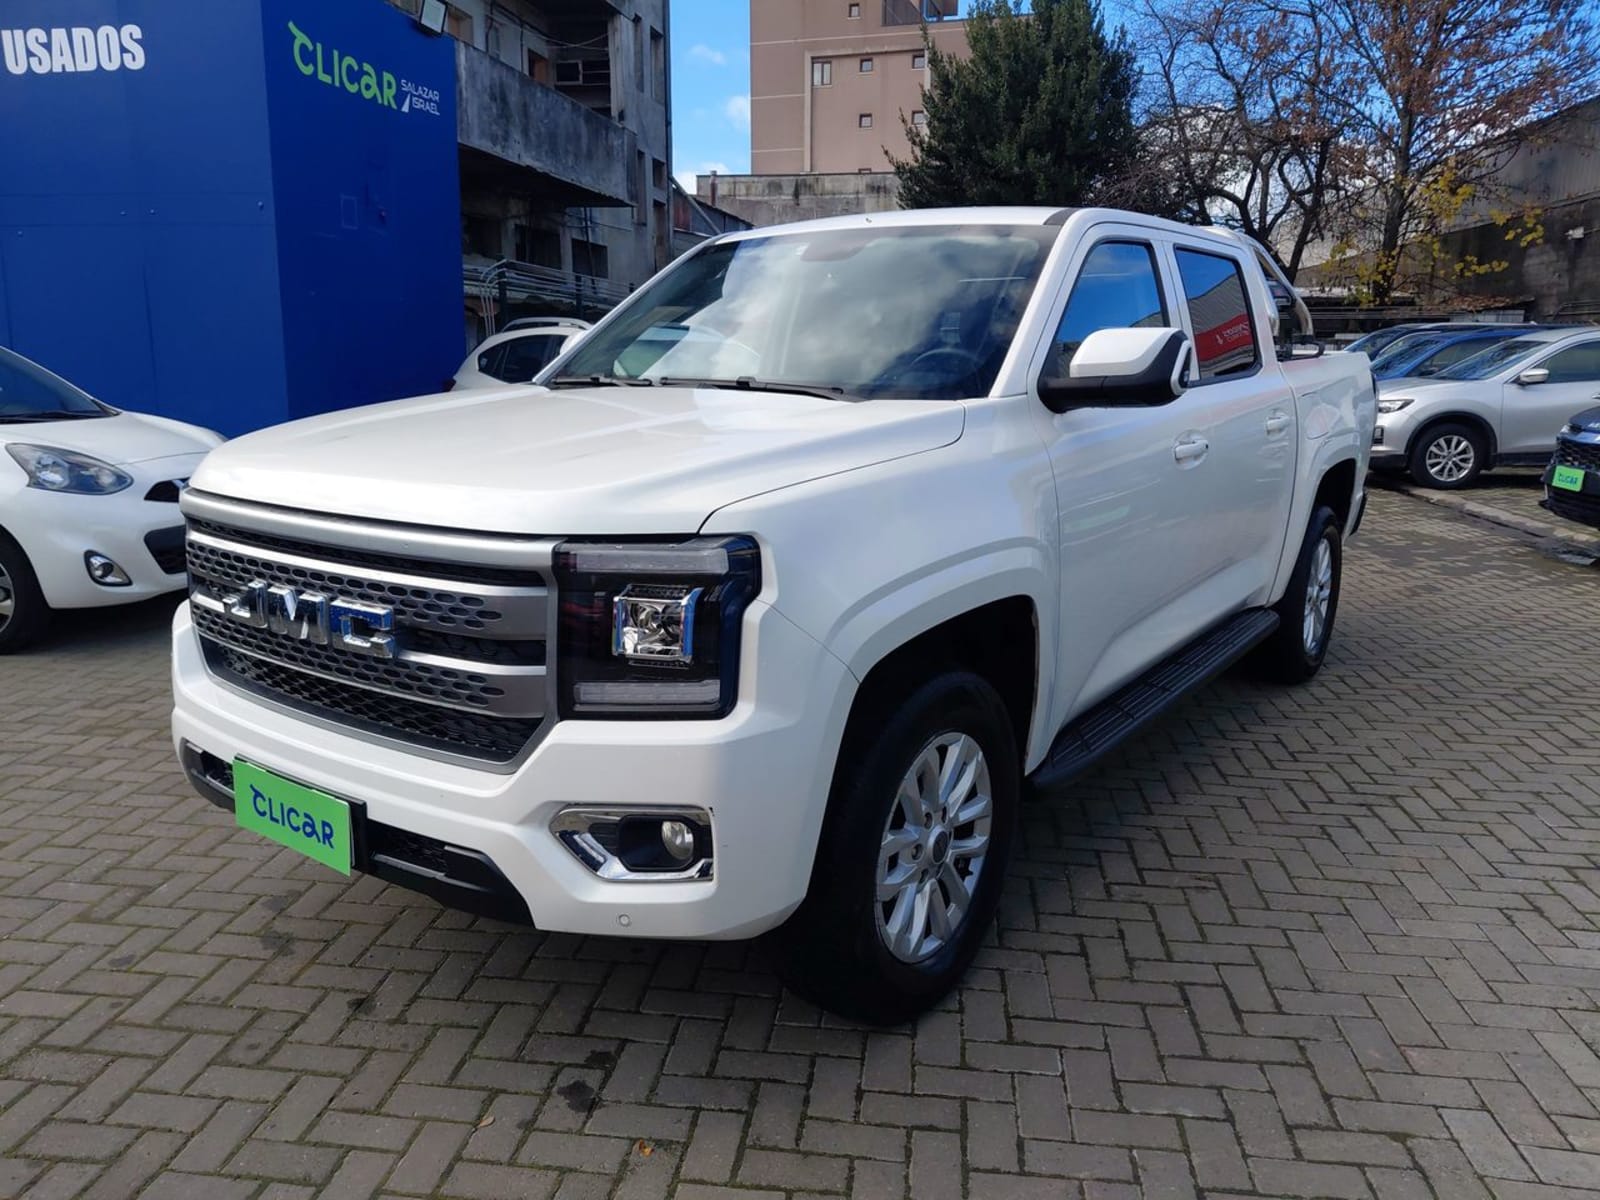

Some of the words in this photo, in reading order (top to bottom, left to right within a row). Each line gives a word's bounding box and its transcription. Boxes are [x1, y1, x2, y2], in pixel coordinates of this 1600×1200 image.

[2, 24, 145, 74] USADOS
[400, 79, 440, 102] SALAZAR
[411, 95, 441, 116] ISRAEL
[223, 579, 394, 658] JMC
